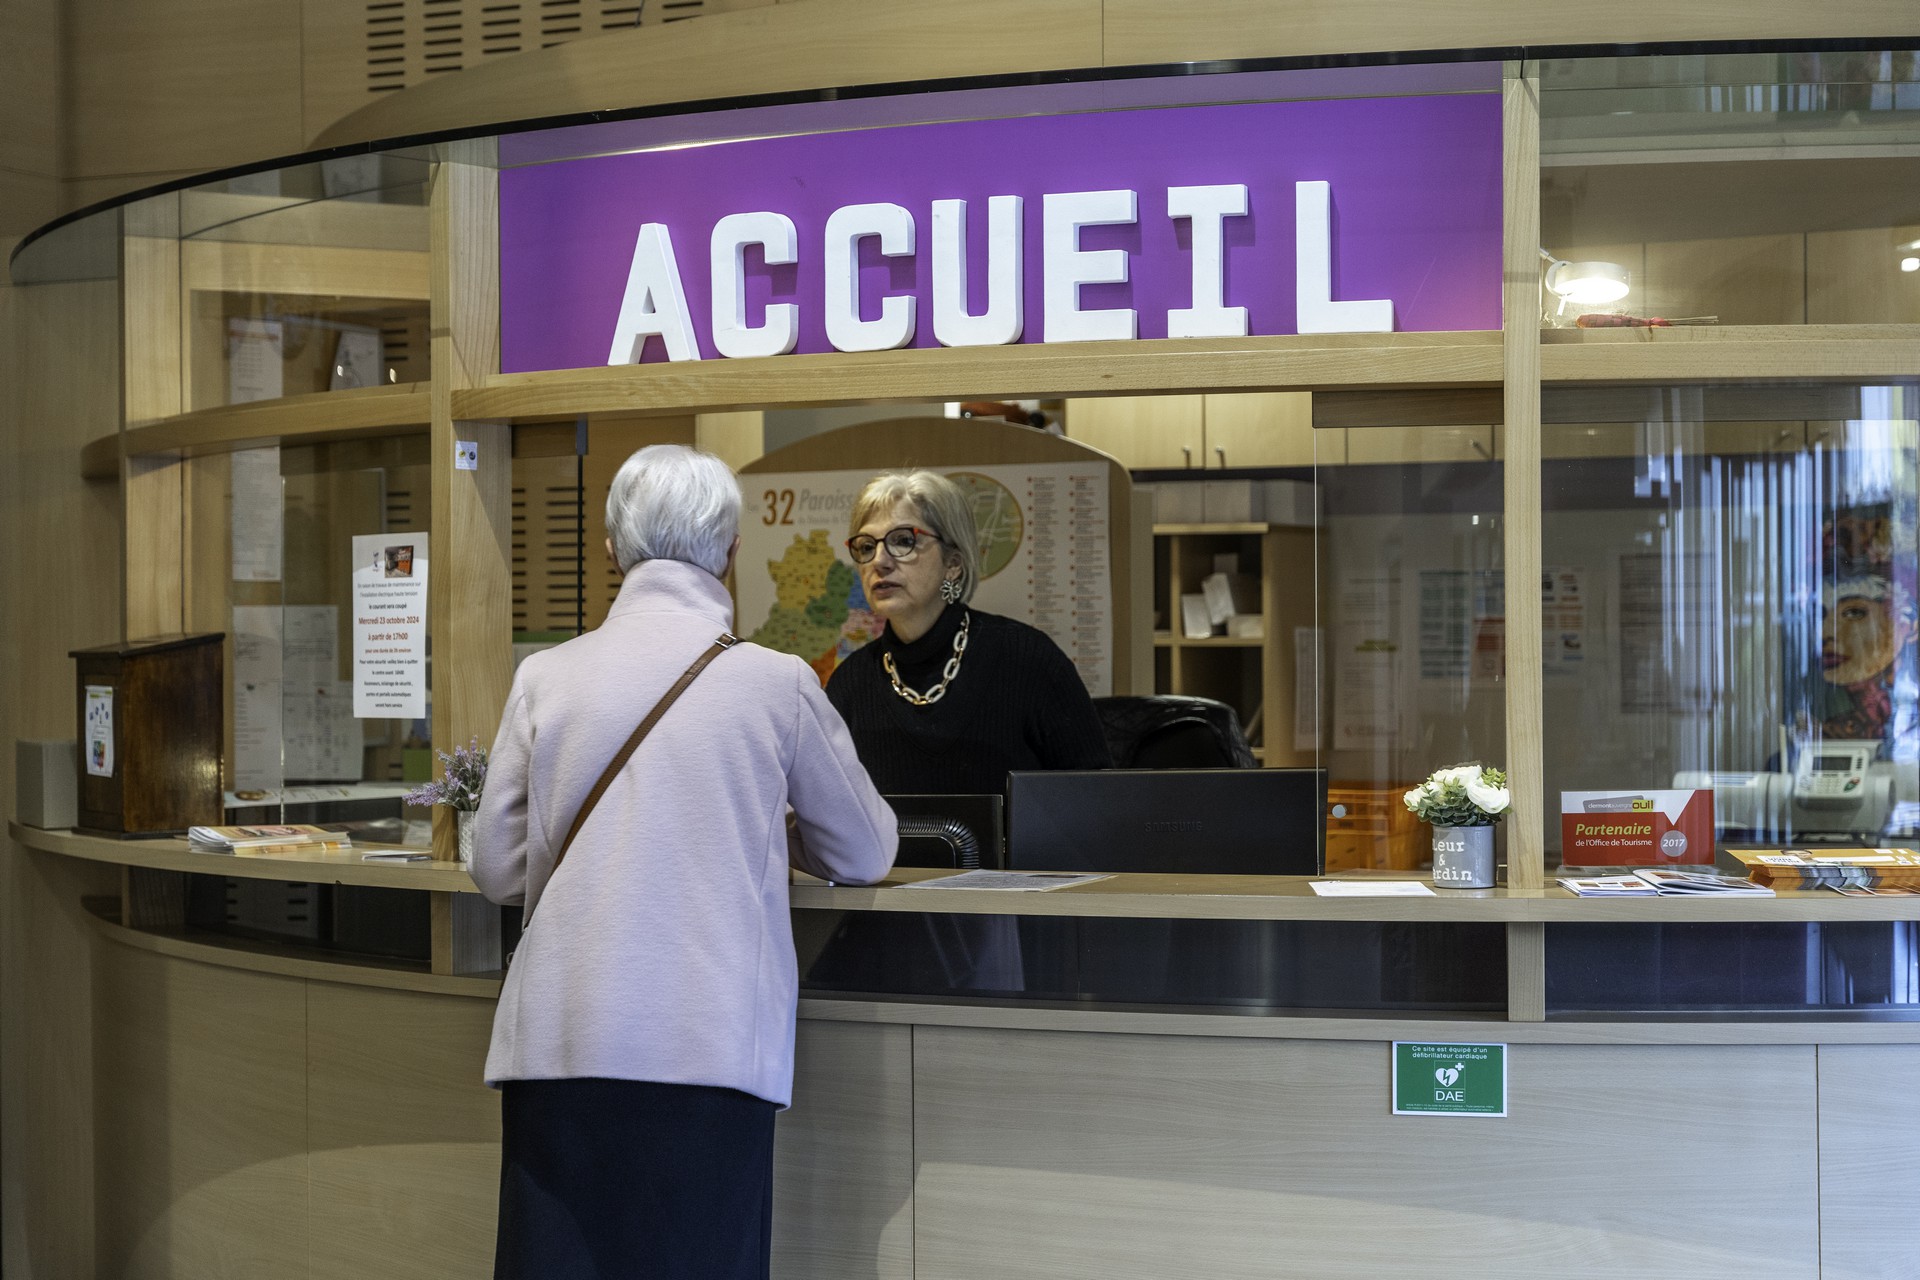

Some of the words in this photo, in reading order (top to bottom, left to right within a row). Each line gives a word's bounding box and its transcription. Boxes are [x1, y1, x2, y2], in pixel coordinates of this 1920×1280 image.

[608, 180, 1395, 365] ACCUEIL
[762, 487, 796, 527] 32
[358, 617, 379, 625] Mercredi
[386, 616, 406, 624] octobre
[406, 615, 419, 624] 2024
[372, 633, 385, 641] partir
[393, 632, 408, 640] 17h00
[1632, 800, 1654, 810] oui!
[1575, 823, 1652, 836] Partenaire
[1575, 839, 1585, 847] de
[1586, 838, 1610, 847] l'Office
[1621, 838, 1653, 846] Tourisme
[1662, 839, 1685, 847] 2017
[1438, 854, 1446, 866] &
[1449, 1046, 1471, 1054] équipé
[1435, 1090, 1464, 1102] DAE
